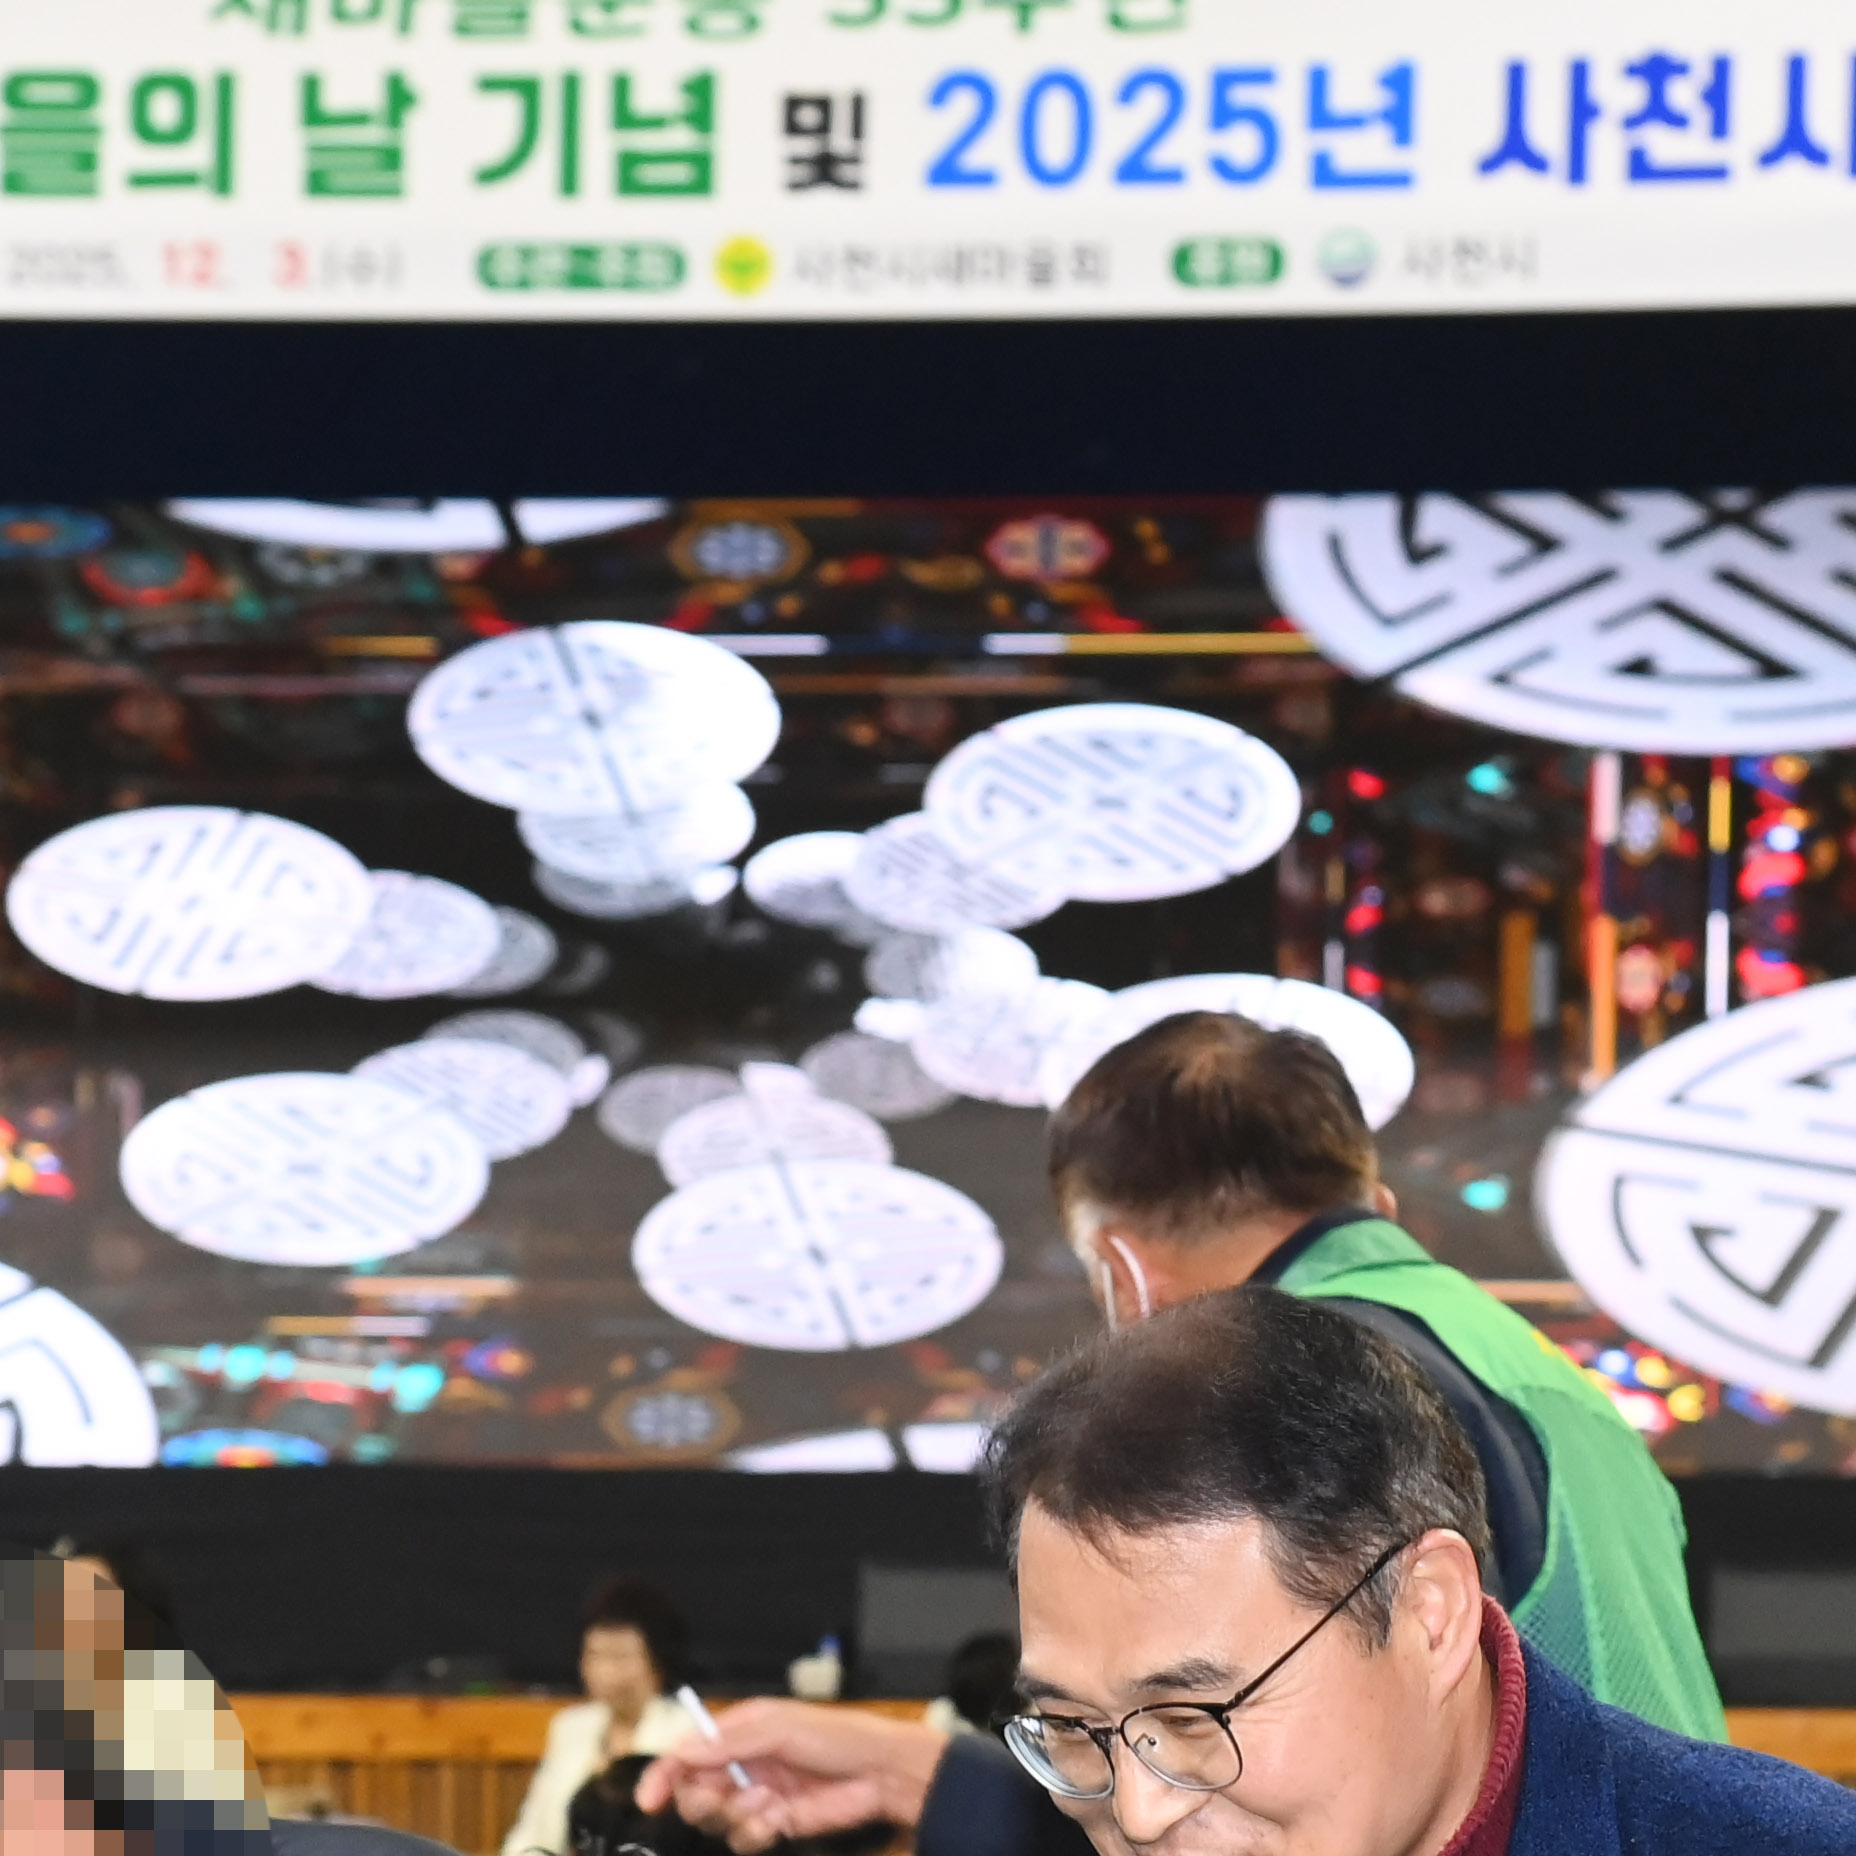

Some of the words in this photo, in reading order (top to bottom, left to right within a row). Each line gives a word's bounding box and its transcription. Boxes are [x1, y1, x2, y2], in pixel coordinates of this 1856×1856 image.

[297, 69, 421, 201] 날
[472, 67, 720, 201] 기념
[780, 90, 868, 194] 및
[923, 58, 1418, 193] 2025년
